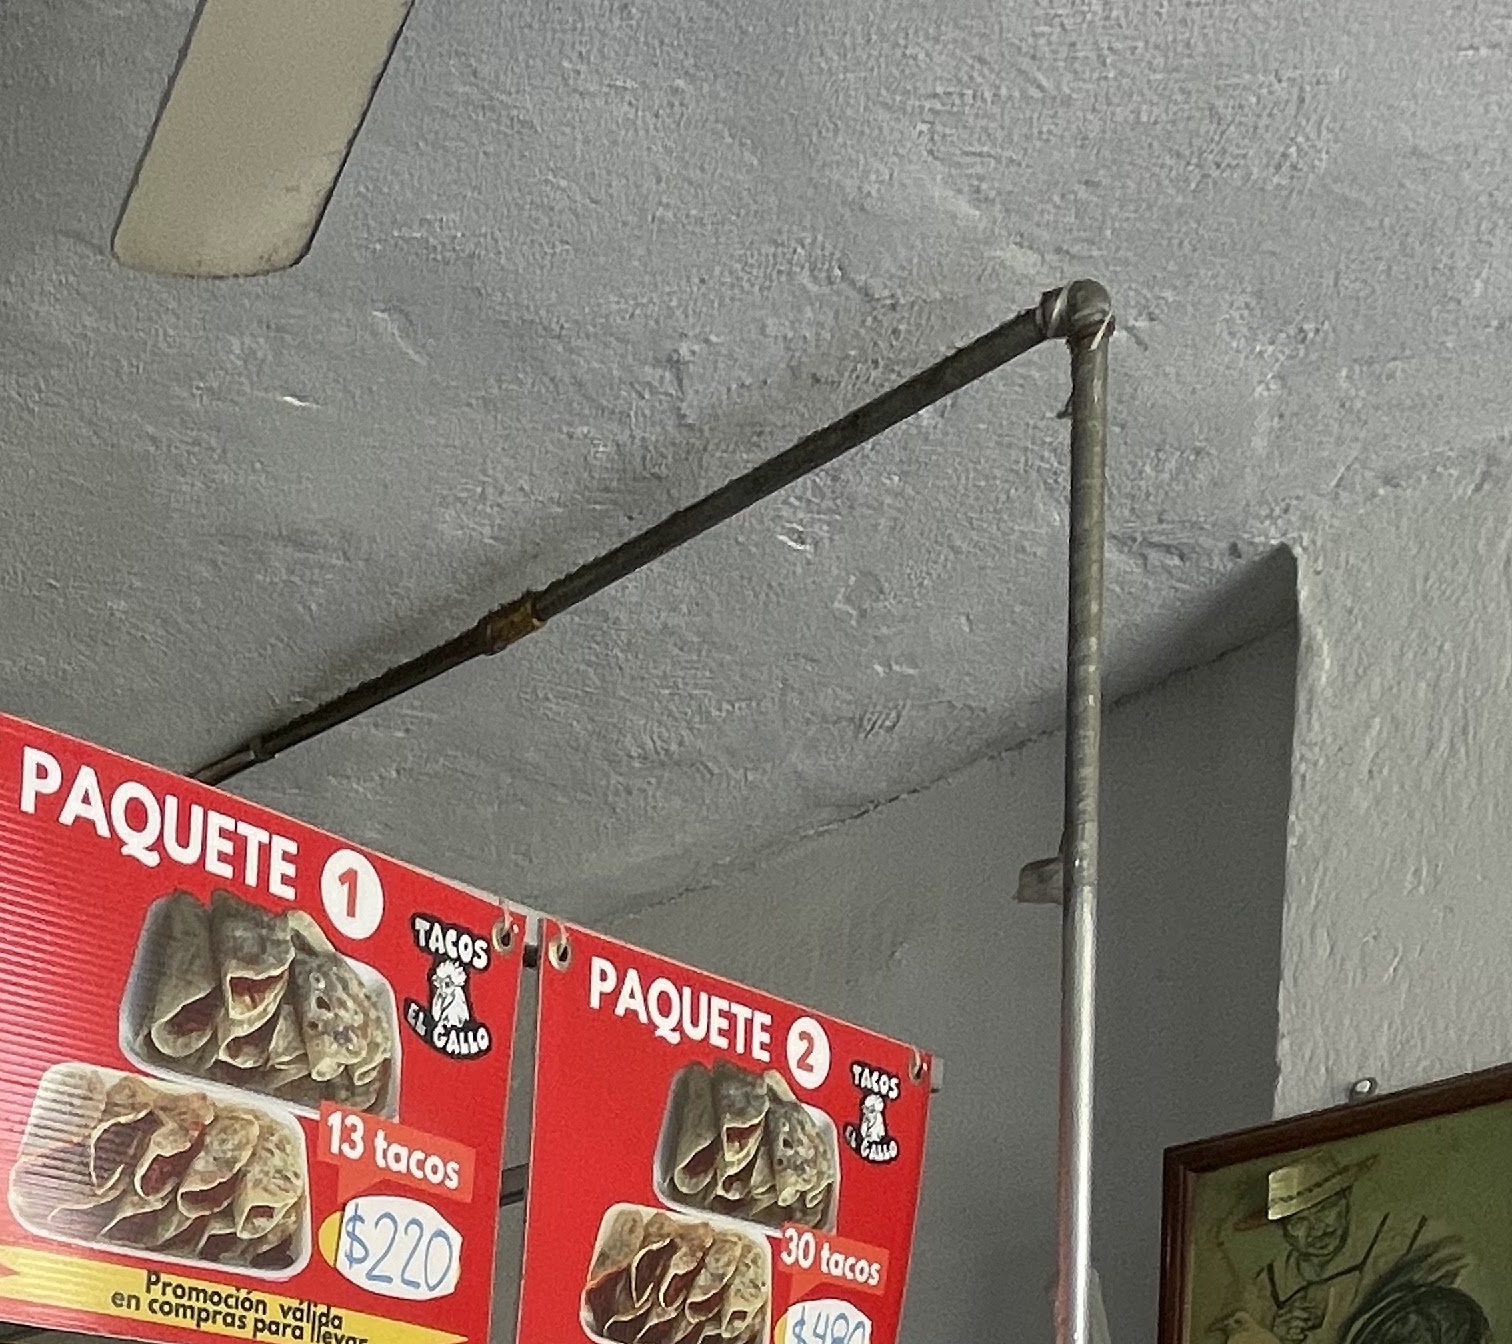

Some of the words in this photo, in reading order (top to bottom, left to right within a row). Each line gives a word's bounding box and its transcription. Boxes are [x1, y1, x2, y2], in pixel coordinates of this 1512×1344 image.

[21, 746, 299, 901] PAQUETE
[337, 867, 359, 920] 1
[414, 917, 488, 969] TACOS
[407, 1003, 426, 1036] EL
[432, 1024, 489, 1055] GALLO
[590, 956, 774, 1063] PAQUETE
[796, 1030, 816, 1072] 2
[852, 1064, 899, 1099] TACOS
[325, 1109, 365, 1161] 13
[373, 1135, 460, 1190] tacos
[343, 1203, 453, 1292] $220
[780, 1229, 812, 1271] 30
[821, 1244, 880, 1286] tacos
[111, 1290, 140, 1311] en
[148, 1299, 247, 1329] compras
[252, 1317, 304, 1340] para
[145, 1270, 267, 1315] Promoción
[279, 1299, 343, 1330] válida
